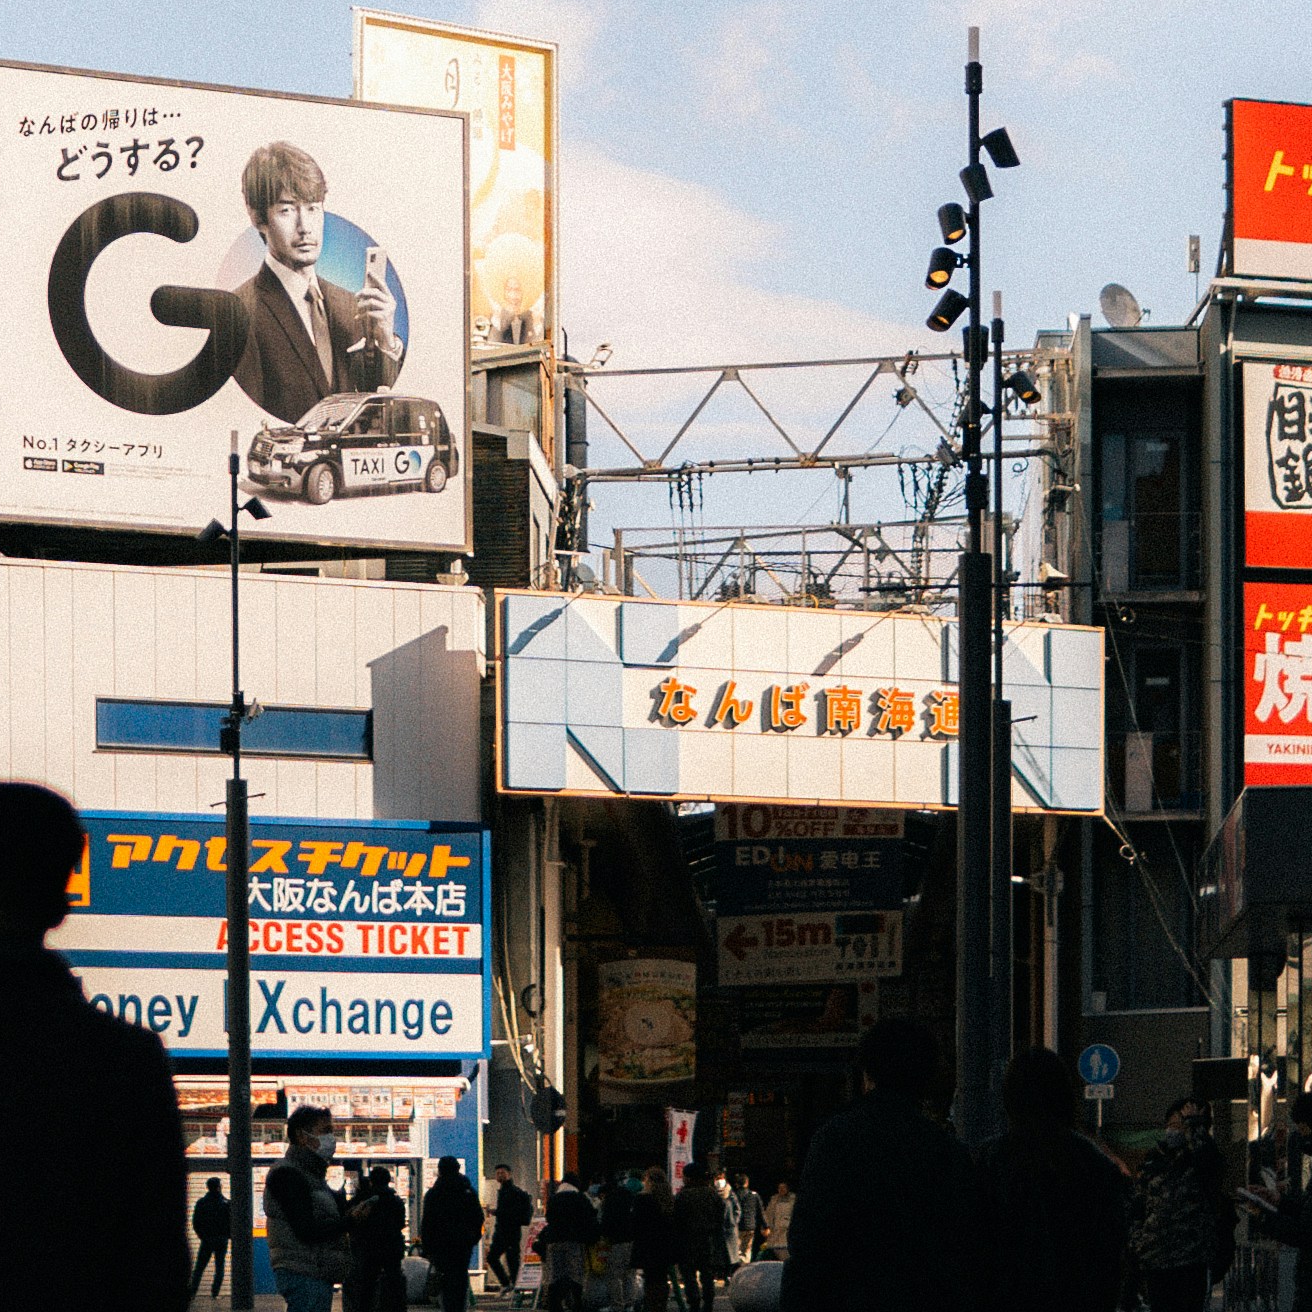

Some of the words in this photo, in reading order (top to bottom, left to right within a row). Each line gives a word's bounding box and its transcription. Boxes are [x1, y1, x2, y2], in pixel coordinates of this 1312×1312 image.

[22, 435, 58, 451] No.1
[66, 438, 163, 459] タクシーアプリ
[351, 458, 385, 475] TAXI
[658, 677, 959, 735] なんば南海通
[722, 804, 771, 838] 10
[106, 833, 471, 879] アクセスチケット
[734, 845, 814, 873] EDION
[248, 877, 468, 917] 大阪なんば本店
[357, 925, 470, 957] TICKET
[762, 919, 832, 947] 15m
[91, 993, 199, 1038] oney
[223, 978, 453, 1040] Xchange
